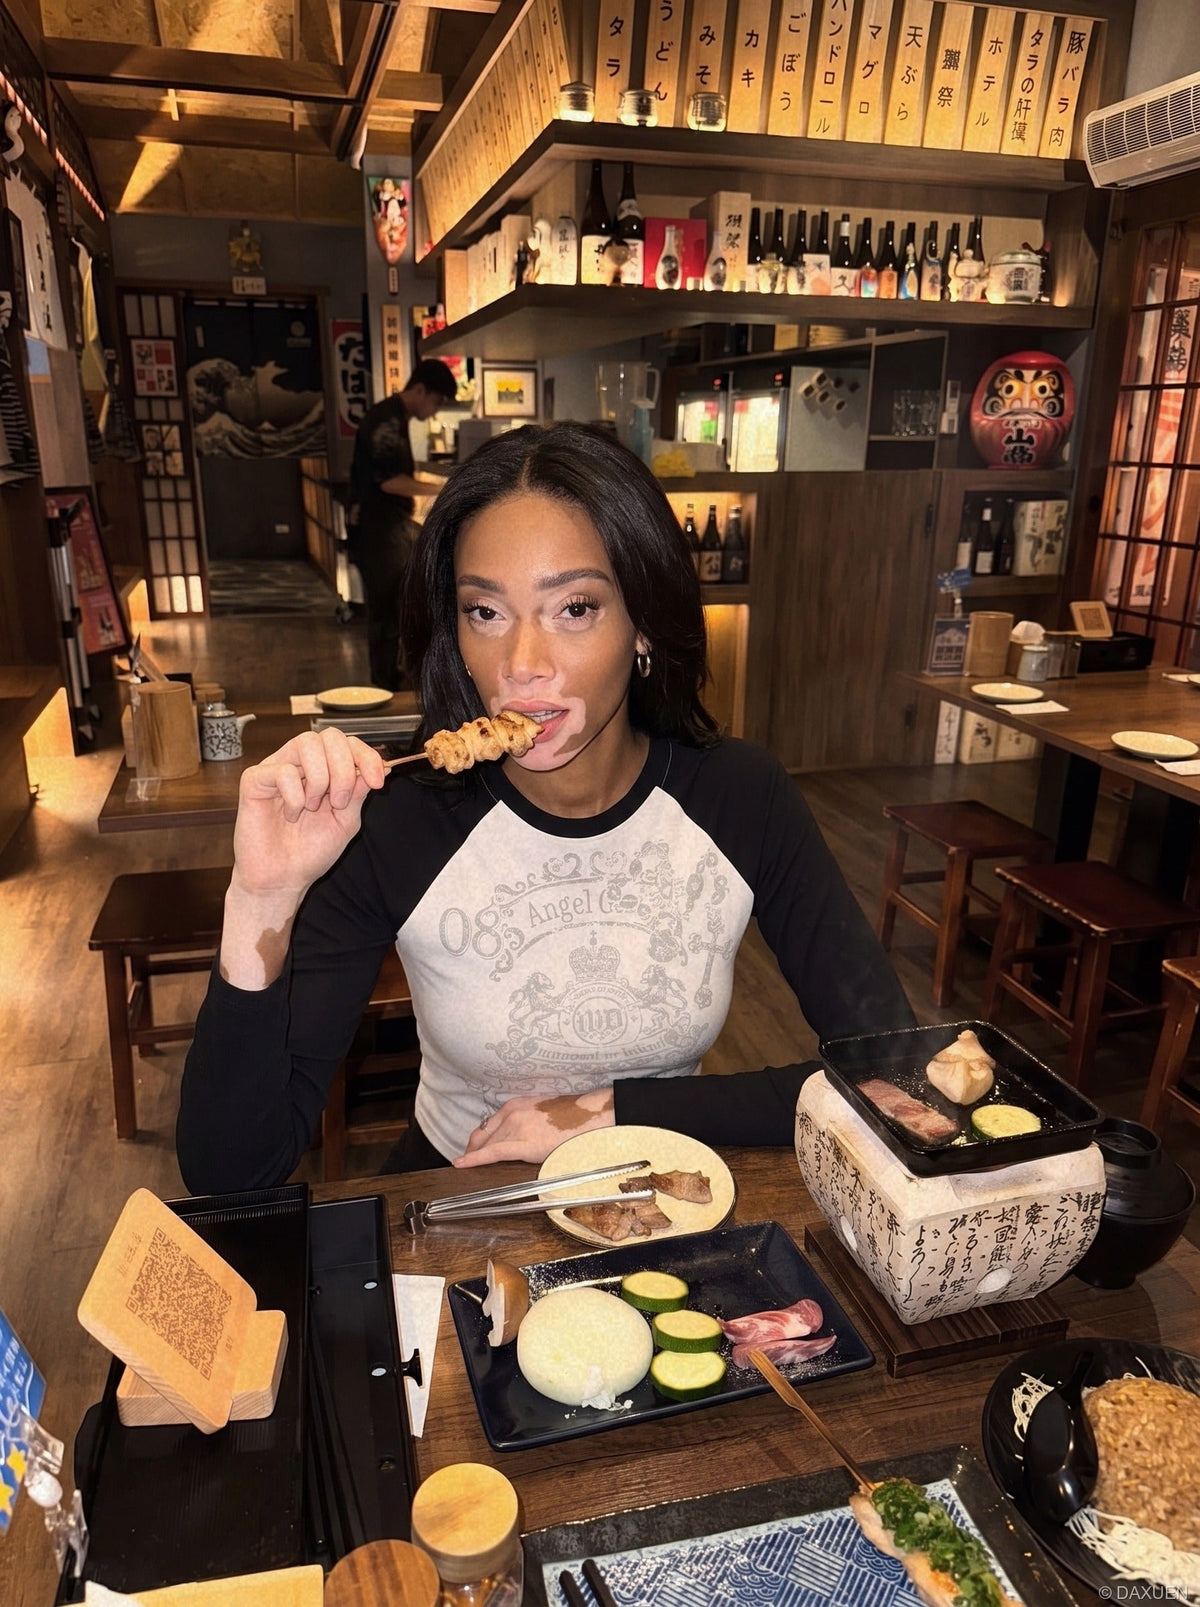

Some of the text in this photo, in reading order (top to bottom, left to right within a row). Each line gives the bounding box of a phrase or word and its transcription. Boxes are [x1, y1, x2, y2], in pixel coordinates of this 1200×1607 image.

[606, 16, 624, 77] タラ
[696, 25, 716, 85] みそ
[741, 29, 760, 88] カキ
[780, 12, 806, 111] ごぼう
[859, 24, 882, 114] マグロ
[1049, 30, 1087, 147] 豚バラ肉
[439, 907, 503, 961] 08
[528, 889, 593, 928] Angel
